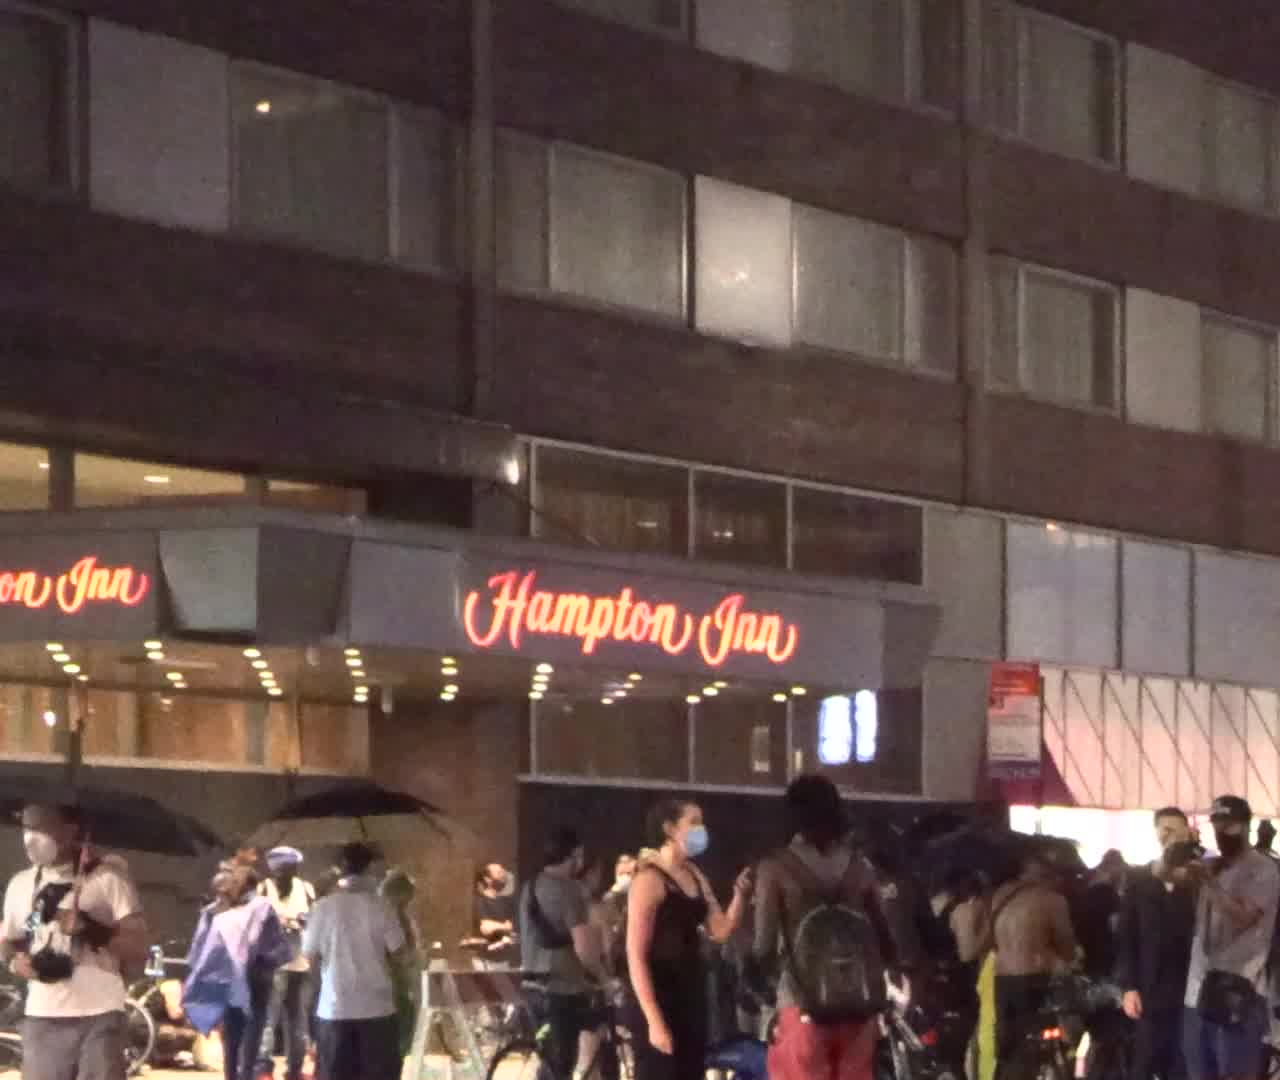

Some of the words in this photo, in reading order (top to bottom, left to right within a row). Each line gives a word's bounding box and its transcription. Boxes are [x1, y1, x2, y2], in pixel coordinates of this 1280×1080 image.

[56, 556, 149, 613] Inn
[464, 570, 692, 655] Hampton
[699, 594, 796, 666] Inn
